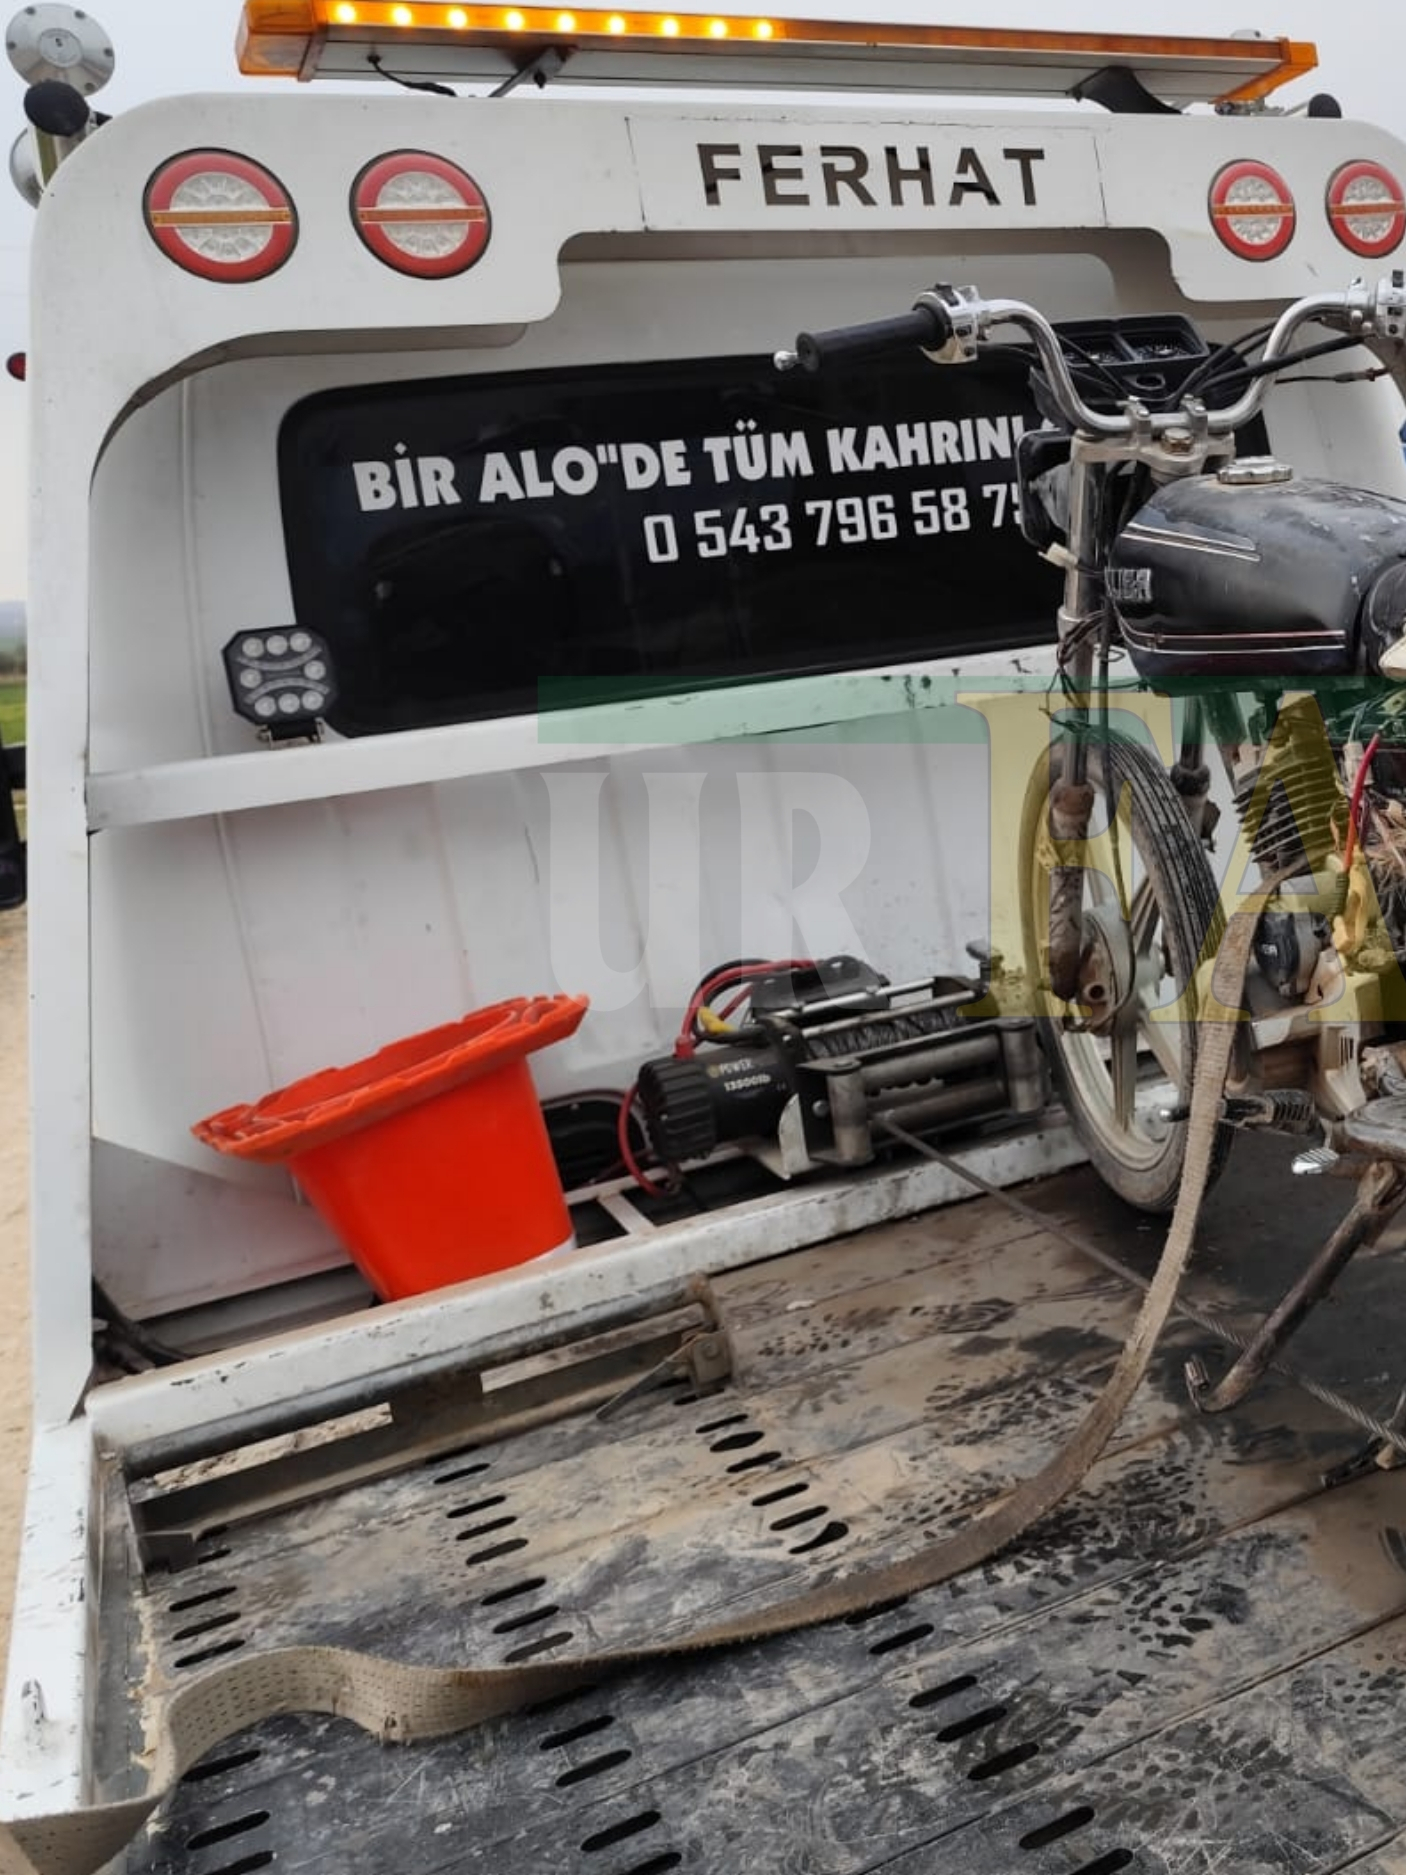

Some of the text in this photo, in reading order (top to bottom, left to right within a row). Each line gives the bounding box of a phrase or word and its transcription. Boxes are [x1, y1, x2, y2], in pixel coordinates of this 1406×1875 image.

[697, 143, 1045, 206] FERHAT
[353, 441, 462, 512] BİR
[703, 418, 814, 483] TÜM
[644, 514, 678, 563] 0
[694, 504, 792, 558] 543
[805, 495, 898, 546] 796
[911, 487, 971, 535] 58
